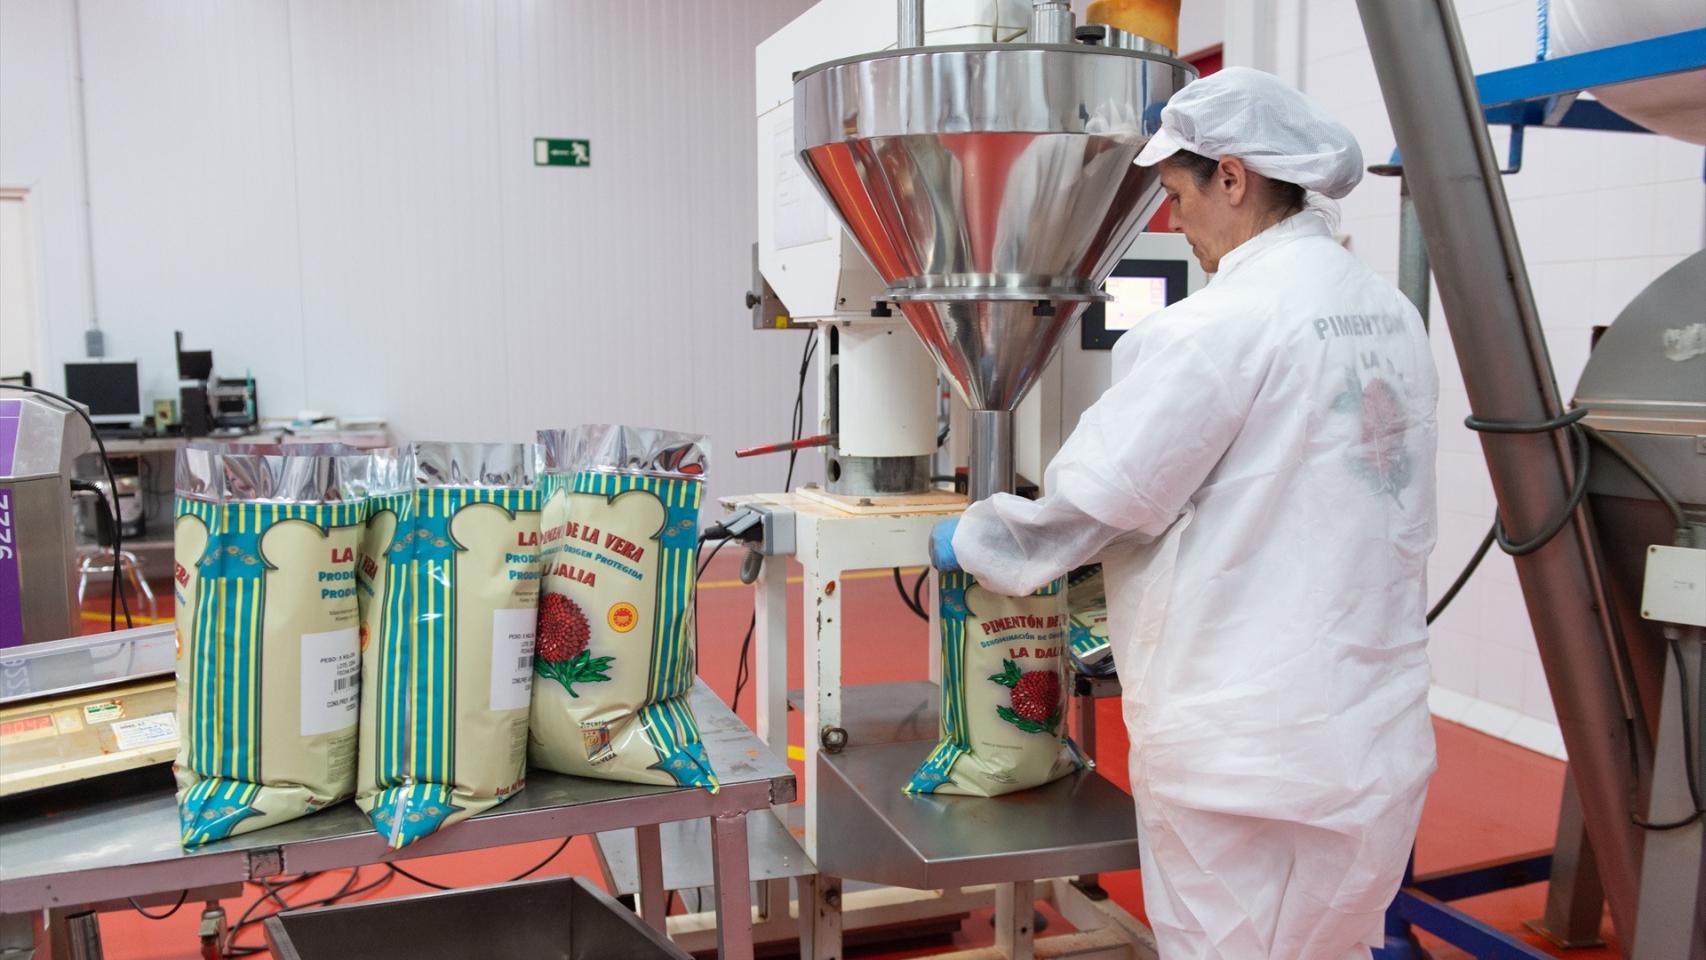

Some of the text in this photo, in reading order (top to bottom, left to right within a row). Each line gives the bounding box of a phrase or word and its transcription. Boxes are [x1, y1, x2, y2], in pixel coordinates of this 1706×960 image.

[517, 531, 538, 547] LA
[565, 521, 580, 539] DE
[580, 525, 601, 545] LA
[604, 533, 645, 564] VERA
[331, 546, 355, 564] LA
[563, 544, 593, 560] ORIGEN
[594, 553, 644, 581] PROTEGIDA
[981, 614, 1044, 635] PIMENTÓN
[1008, 647, 1030, 659] LA
